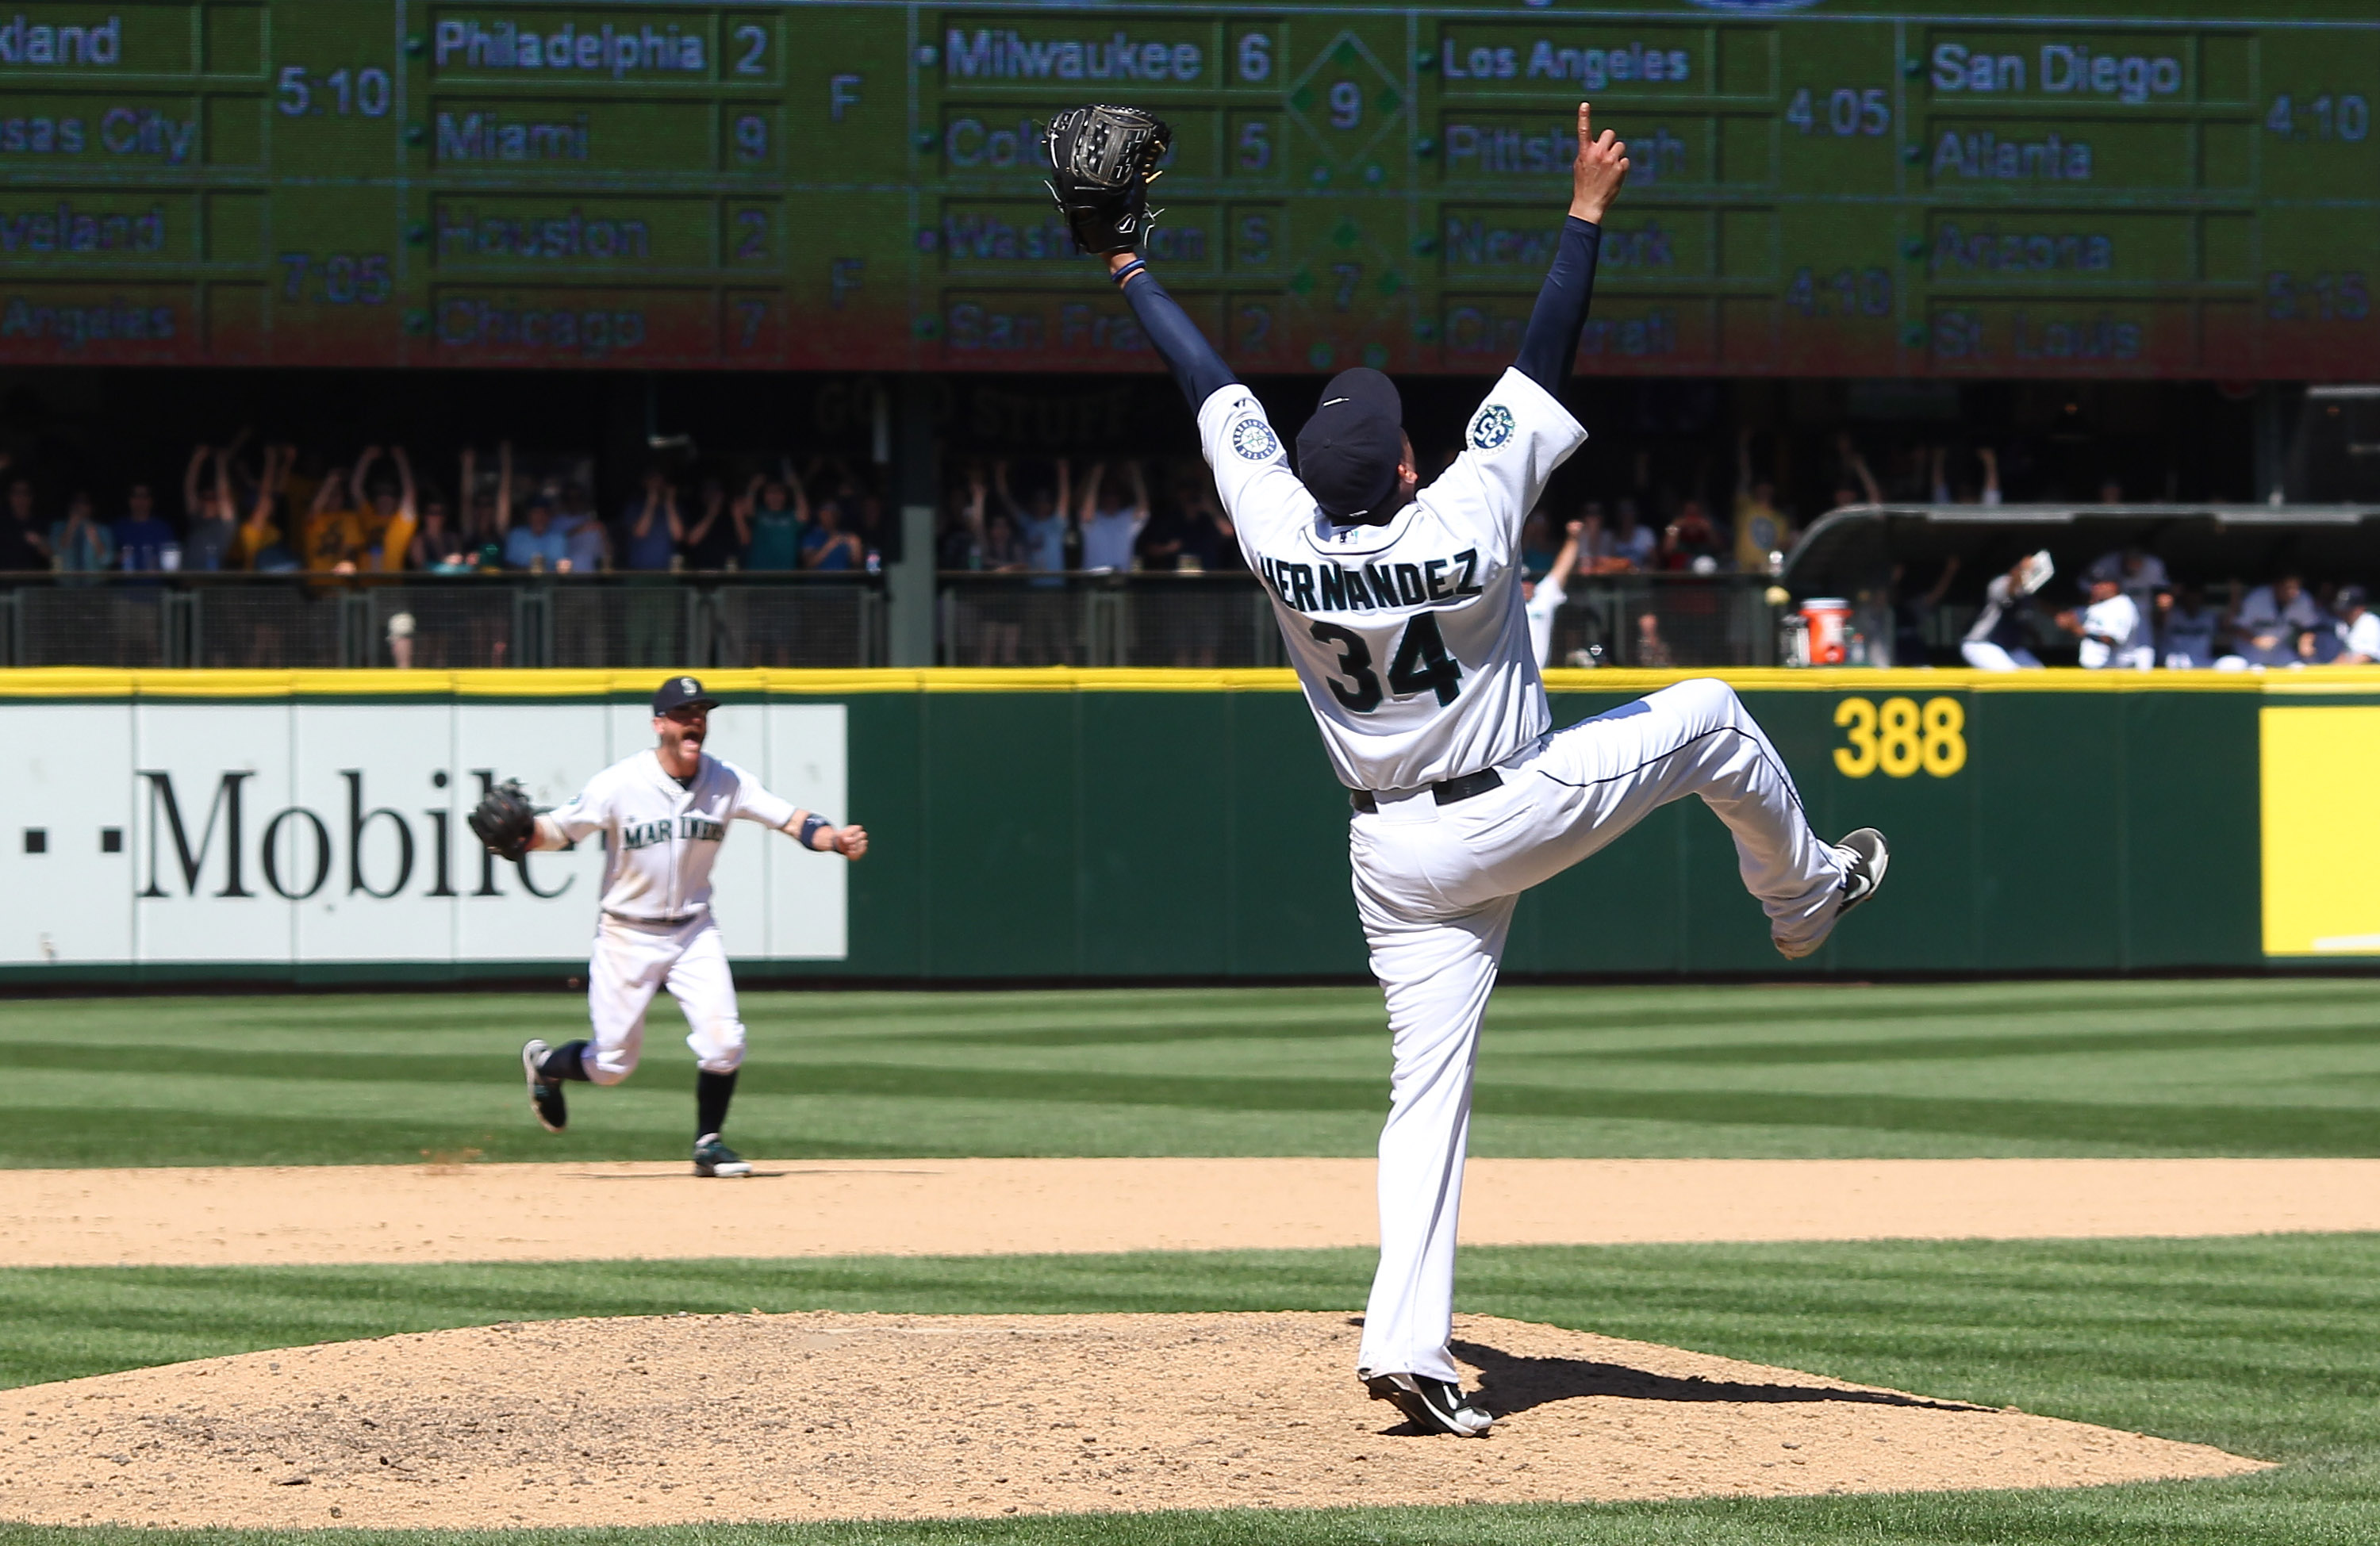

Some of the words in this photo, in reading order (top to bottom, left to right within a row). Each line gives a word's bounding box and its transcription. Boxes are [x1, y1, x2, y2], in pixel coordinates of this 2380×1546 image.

[435, 21, 707, 79] Philadelphia
[735, 25, 768, 73] 2
[946, 29, 1202, 79] Milwaukee
[1238, 34, 1269, 81] 6
[1442, 36, 1517, 79] Los
[1527, 39, 1689, 91] Angeles
[1931, 42, 2026, 92] San
[2040, 44, 2182, 104] Diego
[278, 66, 391, 117] 5:10
[831, 75, 863, 121] F
[1330, 82, 1361, 129] 9
[1787, 88, 1891, 136] 4:05
[101, 107, 196, 165] City
[436, 111, 589, 159] Miami
[735, 116, 768, 163] 9
[2266, 94, 2370, 141] 4:10
[1240, 122, 1269, 169] 5
[1931, 131, 2092, 179] Atlanta
[436, 205, 648, 258] Houston
[737, 210, 768, 259] 2
[1929, 224, 2111, 271] Arizona
[278, 254, 391, 304] 7:05
[1332, 263, 1363, 310] 7
[436, 299, 647, 359] Chicago
[950, 303, 1044, 350] San
[1260, 547, 1483, 612] HERNANDEZ
[1310, 611, 1463, 713] 34
[1833, 697, 1966, 777] 388
